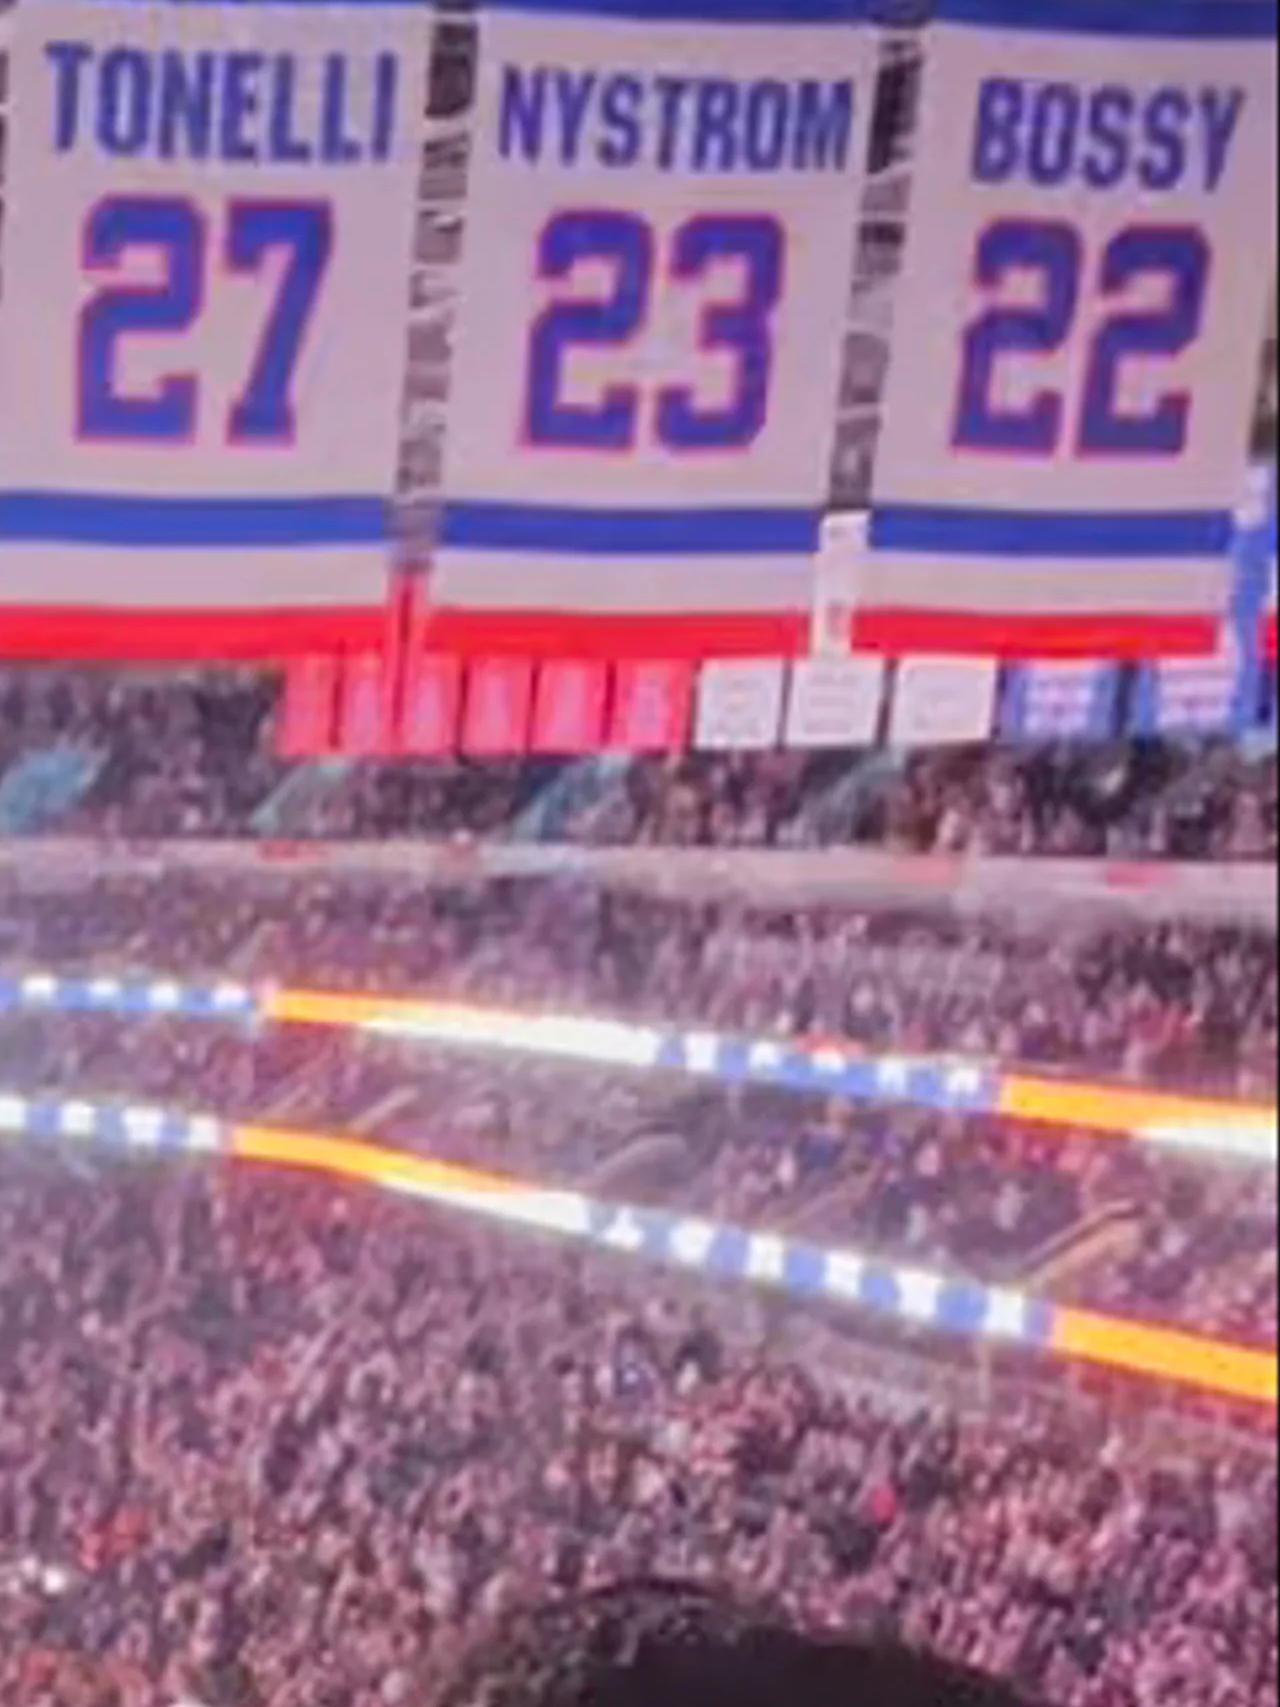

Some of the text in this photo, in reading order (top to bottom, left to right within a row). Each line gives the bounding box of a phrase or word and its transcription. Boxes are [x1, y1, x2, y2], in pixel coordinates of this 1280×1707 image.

[45, 39, 397, 164] TONELLI
[498, 64, 855, 173] NYSTROM
[971, 76, 1245, 191] BOSSY
[74, 193, 337, 447] 27
[519, 207, 788, 454] 23
[949, 216, 1214, 459] 22
